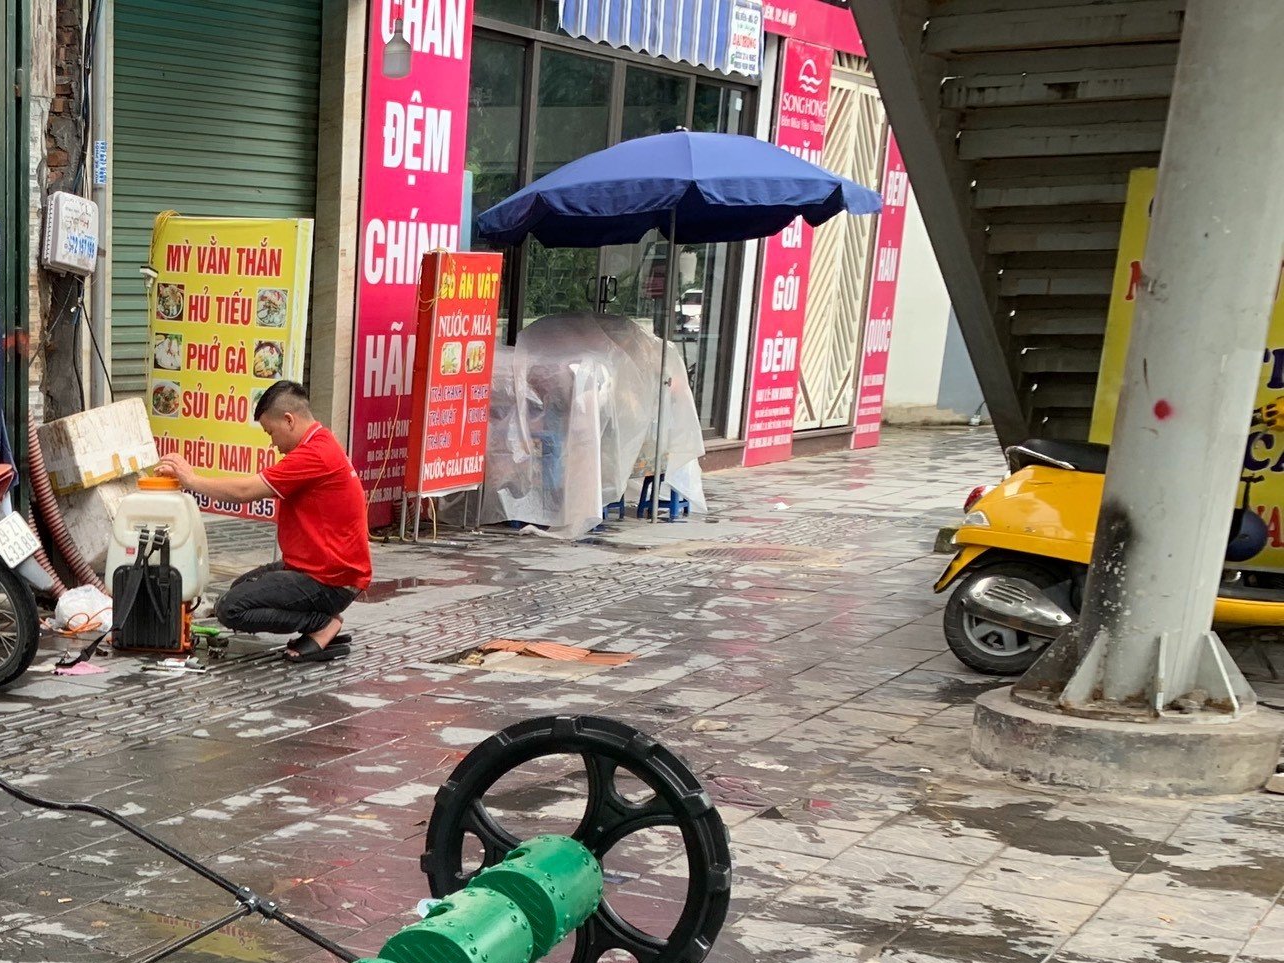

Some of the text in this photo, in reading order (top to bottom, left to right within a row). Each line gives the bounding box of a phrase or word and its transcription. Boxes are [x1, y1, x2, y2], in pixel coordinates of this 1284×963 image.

[383, 90, 452, 186] ĐỆM
[166, 236, 282, 276] MỲ VẰN THẮN
[459, 265, 474, 299] ĂN
[772, 262, 801, 311] GỐI
[188, 286, 252, 325] HỦ TIẾU
[438, 309, 491, 337] NƯỚC MÍA
[186, 336, 247, 374] PHỞ GÀ
[760, 330, 798, 380] ĐỆM
[182, 383, 248, 423] SỦI CẢO
[184, 436, 214, 468] RIÊU
[219, 444, 252, 473] NAM
[423, 451, 484, 481] NƯỚC GIẢI KHÁT
[248, 497, 275, 518] 135
